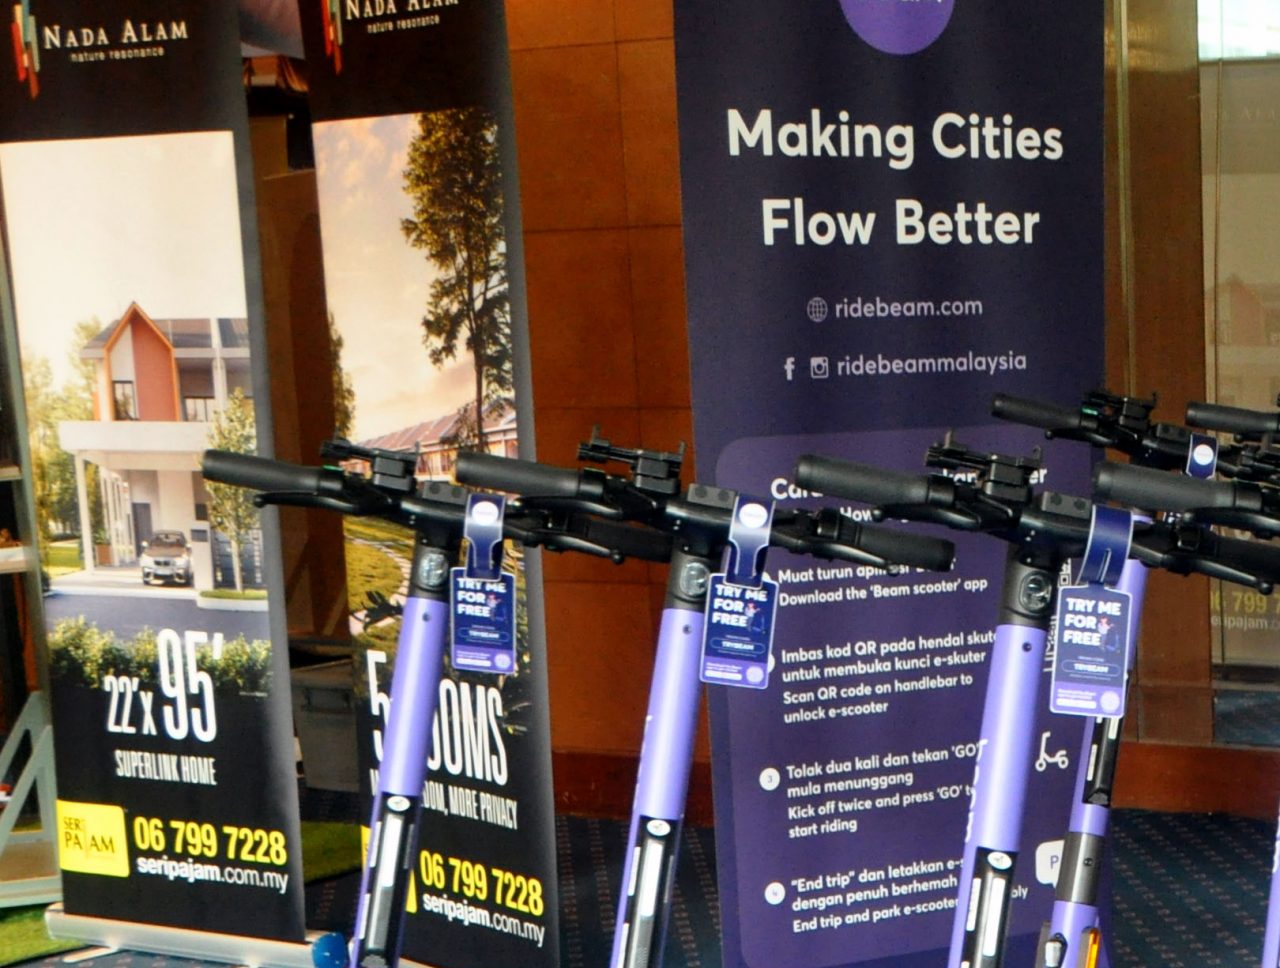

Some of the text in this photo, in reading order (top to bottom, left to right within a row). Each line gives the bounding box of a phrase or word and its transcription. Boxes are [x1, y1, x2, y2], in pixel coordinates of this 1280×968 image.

[43, 19, 188, 49] NADA ALAM
[727, 108, 1063, 170] Making Cities
[762, 197, 1040, 245] Flow Better
[835, 296, 983, 318] ridebeam.com
[837, 350, 1026, 375] ridebeammalaysia
[780, 587, 843, 606] Download
[845, 586, 867, 600] the
[963, 579, 988, 592] app
[1066, 598, 1121, 616] TRY ME
[1064, 614, 1097, 629] FOR
[781, 632, 964, 663] Imbas kod QR pada hendal
[1063, 630, 1102, 646] FREE
[782, 650, 986, 682] untuk membuka kunci e-skuter
[782, 673, 973, 704] Scan QR code on handlebar to
[783, 701, 888, 723] unlock e-scooter
[114, 750, 217, 786] SUPERLINK HOME
[786, 748, 948, 779] Tolak dua kali dan tekan
[787, 772, 913, 798] mula menunggang
[448, 784, 518, 830] MORE PRIVACY
[788, 785, 962, 820] Kick off twice and press 'GO'
[133, 816, 287, 866] 06 799 7228
[788, 818, 857, 838] start riding
[137, 856, 288, 894] seripajam.com.my
[420, 850, 544, 917] 06 799 7228
[858, 869, 885, 883] dan
[888, 861, 944, 878] letakkan
[791, 875, 958, 912] dengan penuh berhemah
[422, 893, 546, 948] seripajam.com.my
[792, 916, 818, 933] End
[819, 914, 842, 929] trip
[844, 908, 870, 924] and
[872, 904, 901, 923] park
